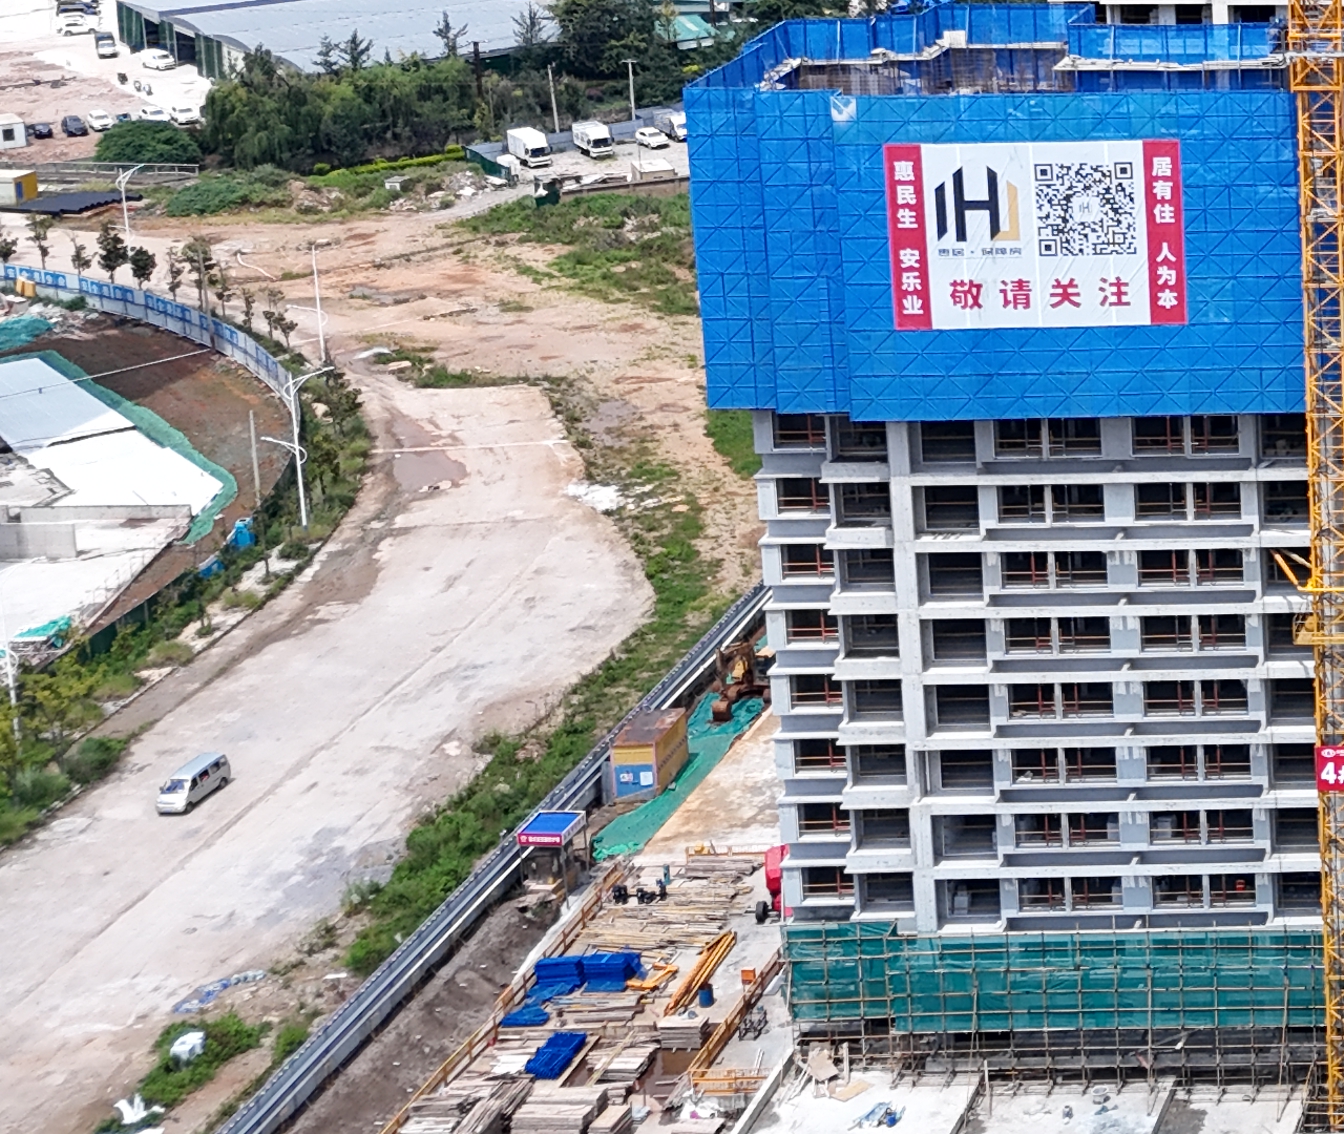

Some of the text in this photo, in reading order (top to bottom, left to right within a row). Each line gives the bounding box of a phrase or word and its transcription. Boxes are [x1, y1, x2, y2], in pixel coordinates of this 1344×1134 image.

[899, 248, 924, 316] 安乐业
[949, 277, 1132, 311] 敬请关注
[1156, 242, 1179, 310] 人为本
